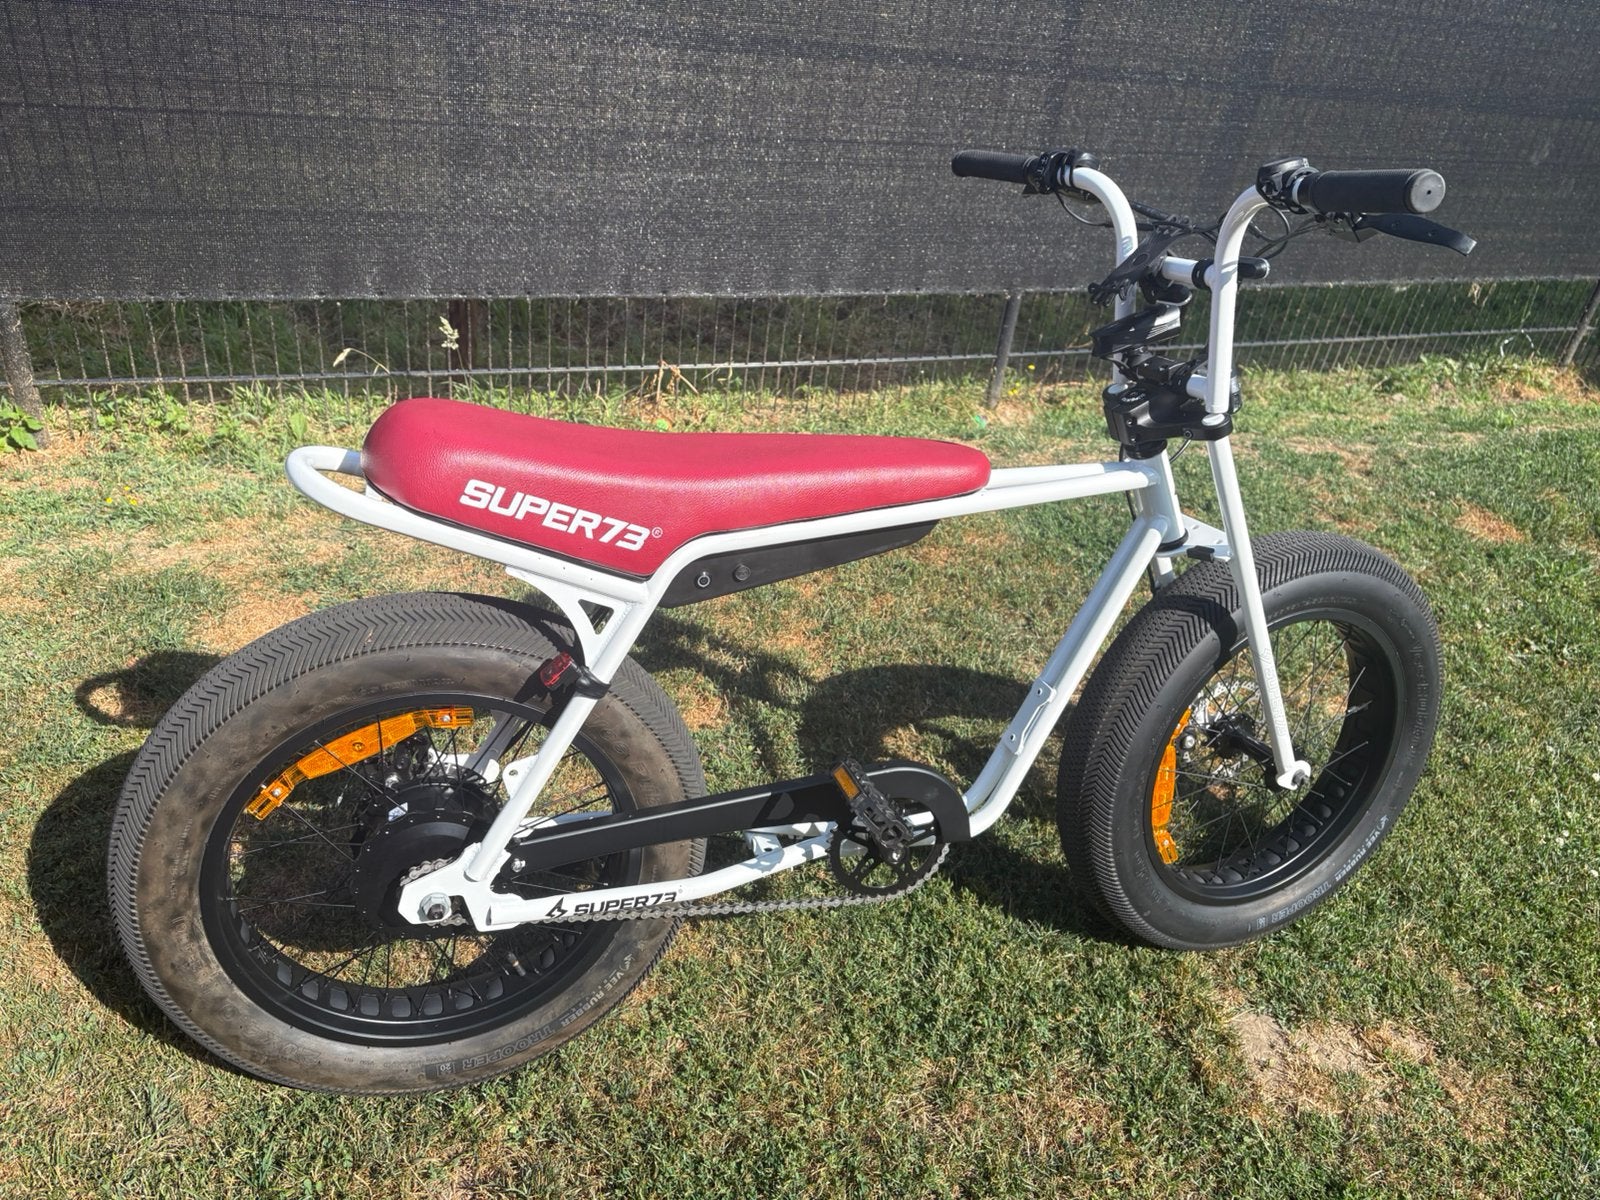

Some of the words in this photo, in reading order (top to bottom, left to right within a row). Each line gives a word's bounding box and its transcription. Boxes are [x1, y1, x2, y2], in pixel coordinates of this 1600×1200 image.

[604, 971, 625, 991] VEE
[561, 990, 605, 1027] RUBBER
[462, 1024, 555, 1070] TROOPER
